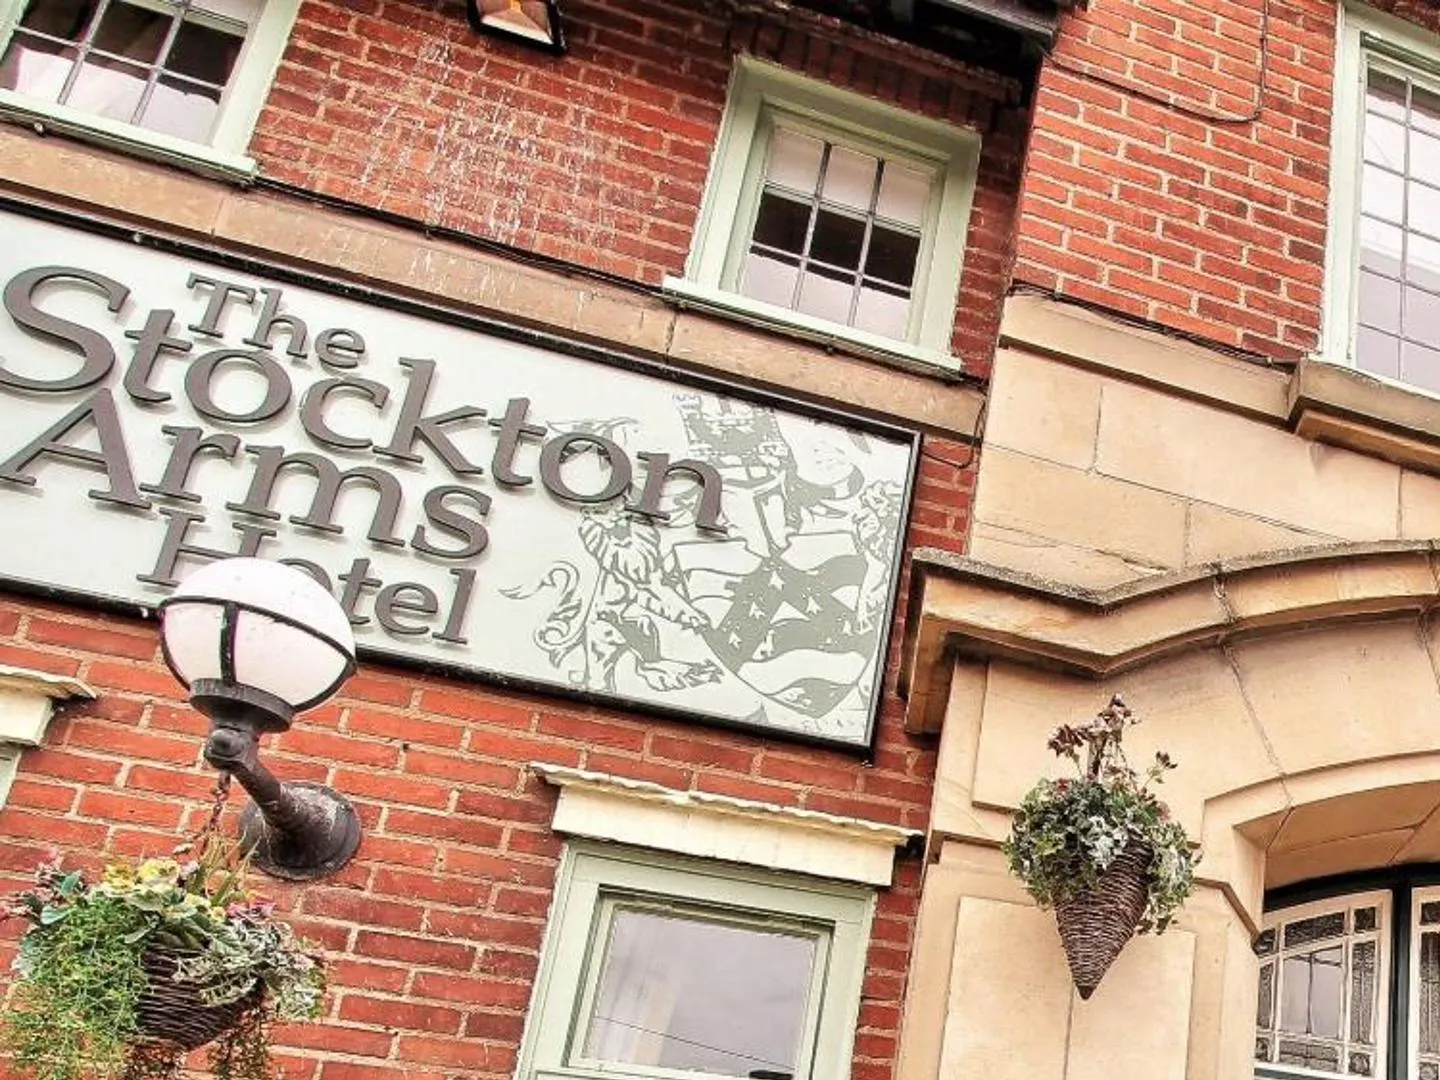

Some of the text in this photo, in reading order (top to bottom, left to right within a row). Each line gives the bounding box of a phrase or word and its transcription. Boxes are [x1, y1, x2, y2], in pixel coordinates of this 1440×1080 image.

[0, 264, 729, 533] Stockton
[187, 273, 368, 369] The
[0, 387, 492, 559] Arms
